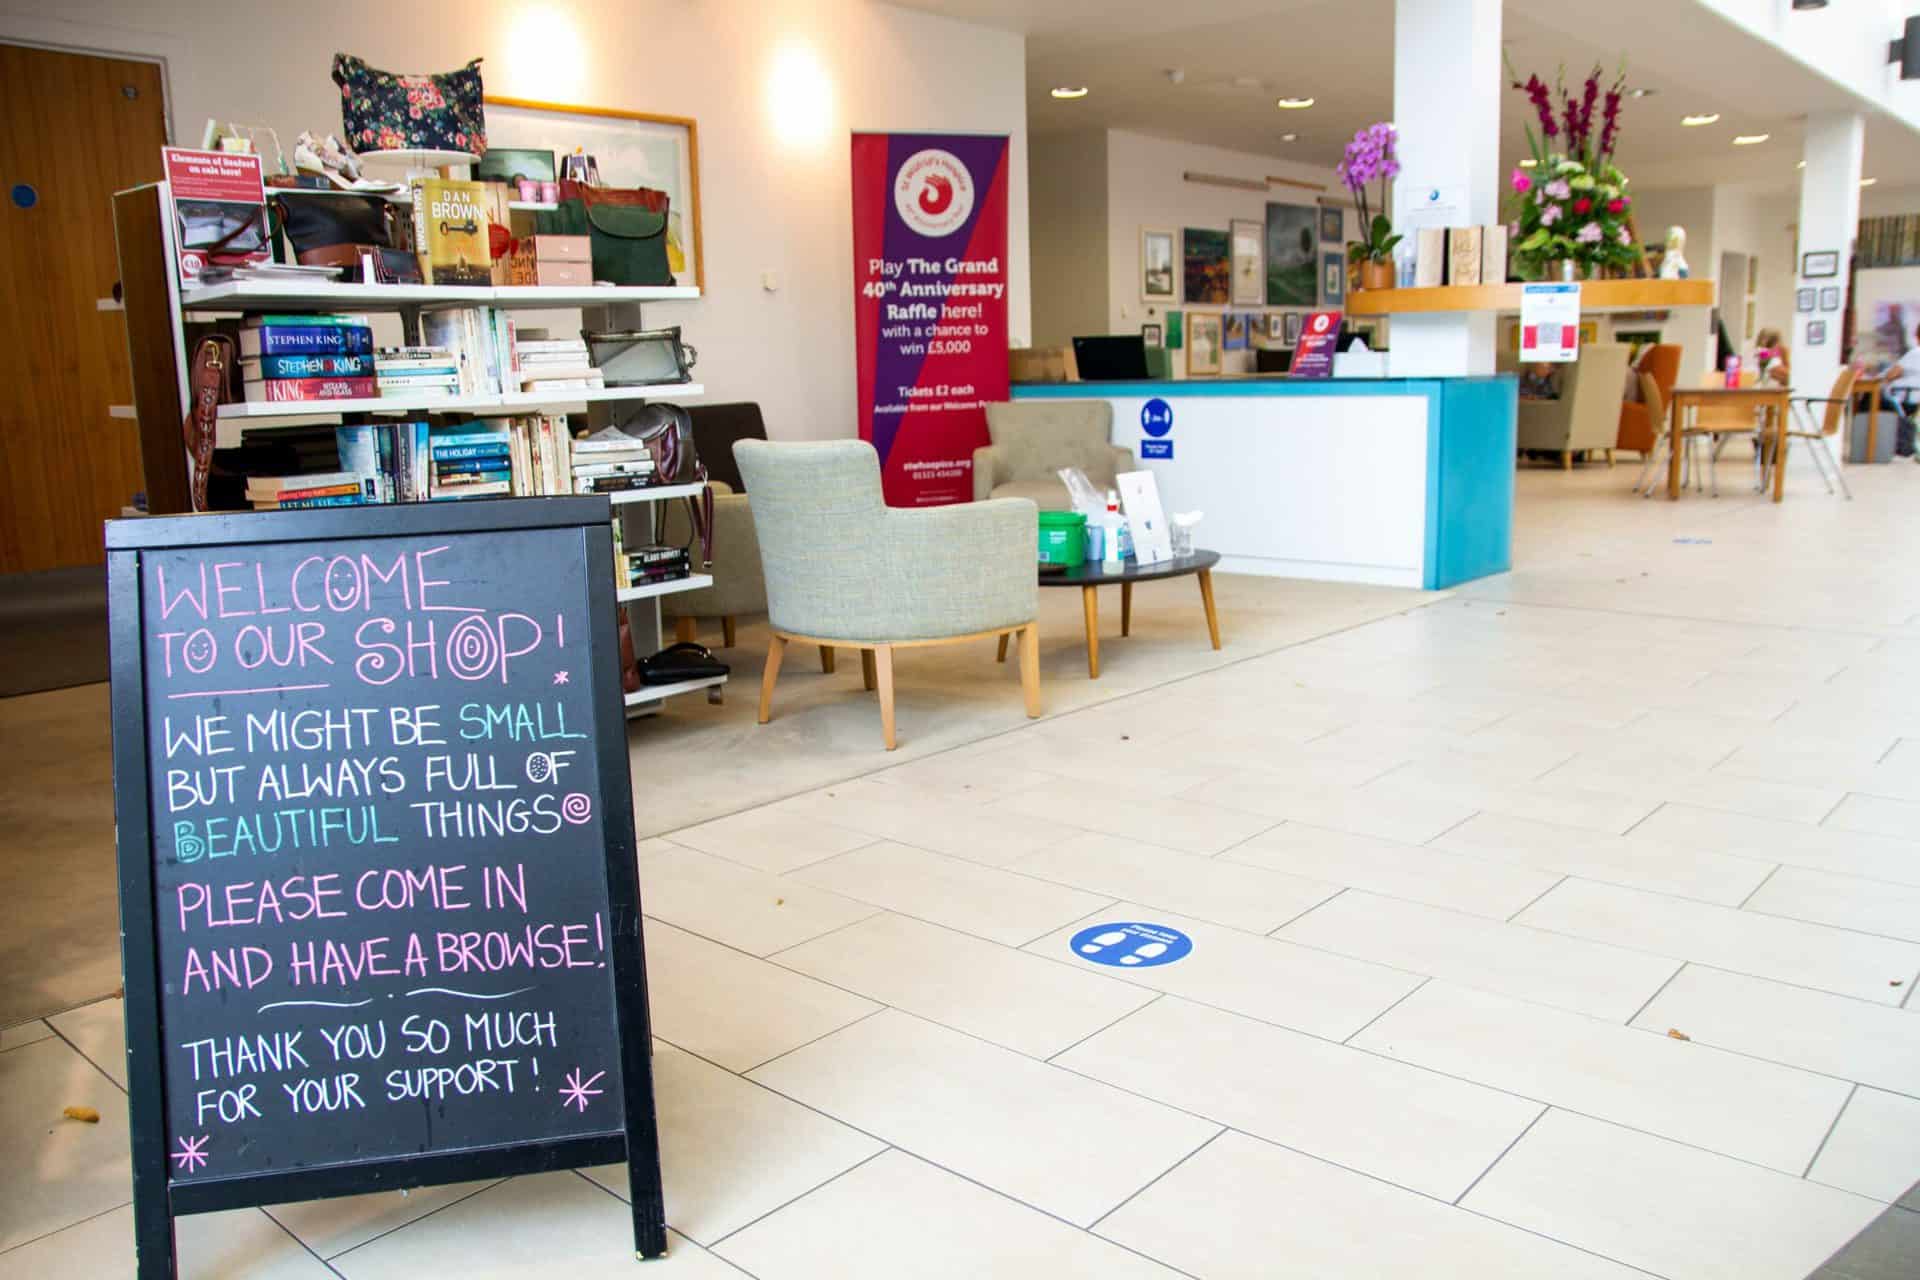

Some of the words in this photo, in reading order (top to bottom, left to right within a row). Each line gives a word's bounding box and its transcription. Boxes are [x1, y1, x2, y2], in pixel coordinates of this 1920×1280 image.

[443, 190, 470, 202] DAN
[432, 202, 485, 219] BROWN
[868, 259, 904, 278] Play
[906, 258, 940, 274] The
[944, 257, 999, 274] Grand
[862, 282, 896, 298] 40th
[900, 280, 1004, 299] Anniversary
[887, 303, 938, 320] Raffle
[941, 303, 983, 319] here!
[267, 335, 316, 345] STEPHEN
[316, 335, 341, 345] KING
[882, 326, 911, 338] with
[913, 328, 922, 337] a
[924, 324, 972, 336] chance
[974, 324, 988, 336] to
[900, 342, 924, 355] win
[928, 340, 971, 356] £5,000
[278, 358, 324, 374] STEPHEN
[333, 356, 361, 374] KING
[273, 380, 304, 401] KING
[898, 386, 934, 398] Tickets
[950, 384, 974, 395] each
[158, 546, 486, 621] WELCOME
[156, 627, 218, 679] TO
[234, 621, 334, 669] OUR
[165, 713, 234, 759] WE
[247, 707, 380, 754] MIGHT
[390, 704, 447, 747] BE
[458, 701, 587, 743] SMALL
[168, 766, 245, 813] BUT
[257, 756, 406, 802] ALWAYS
[425, 753, 517, 792] FULL
[526, 750, 576, 786] OF
[174, 804, 400, 864] BEAUTIFUL
[408, 798, 562, 839] THINGS
[177, 873, 348, 932] PLEASE
[356, 864, 473, 914] COME
[483, 862, 528, 914] IN
[182, 946, 273, 996] AND
[290, 937, 402, 987] HAVE
[404, 932, 428, 978] A
[437, 912, 607, 975] BROWSE!
[182, 1030, 308, 1082] THANK
[319, 1018, 387, 1062] YOU
[401, 1014, 450, 1054] SO
[464, 1010, 558, 1052] MUCH
[196, 1084, 263, 1126] FOR
[283, 1074, 366, 1116] YOUR
